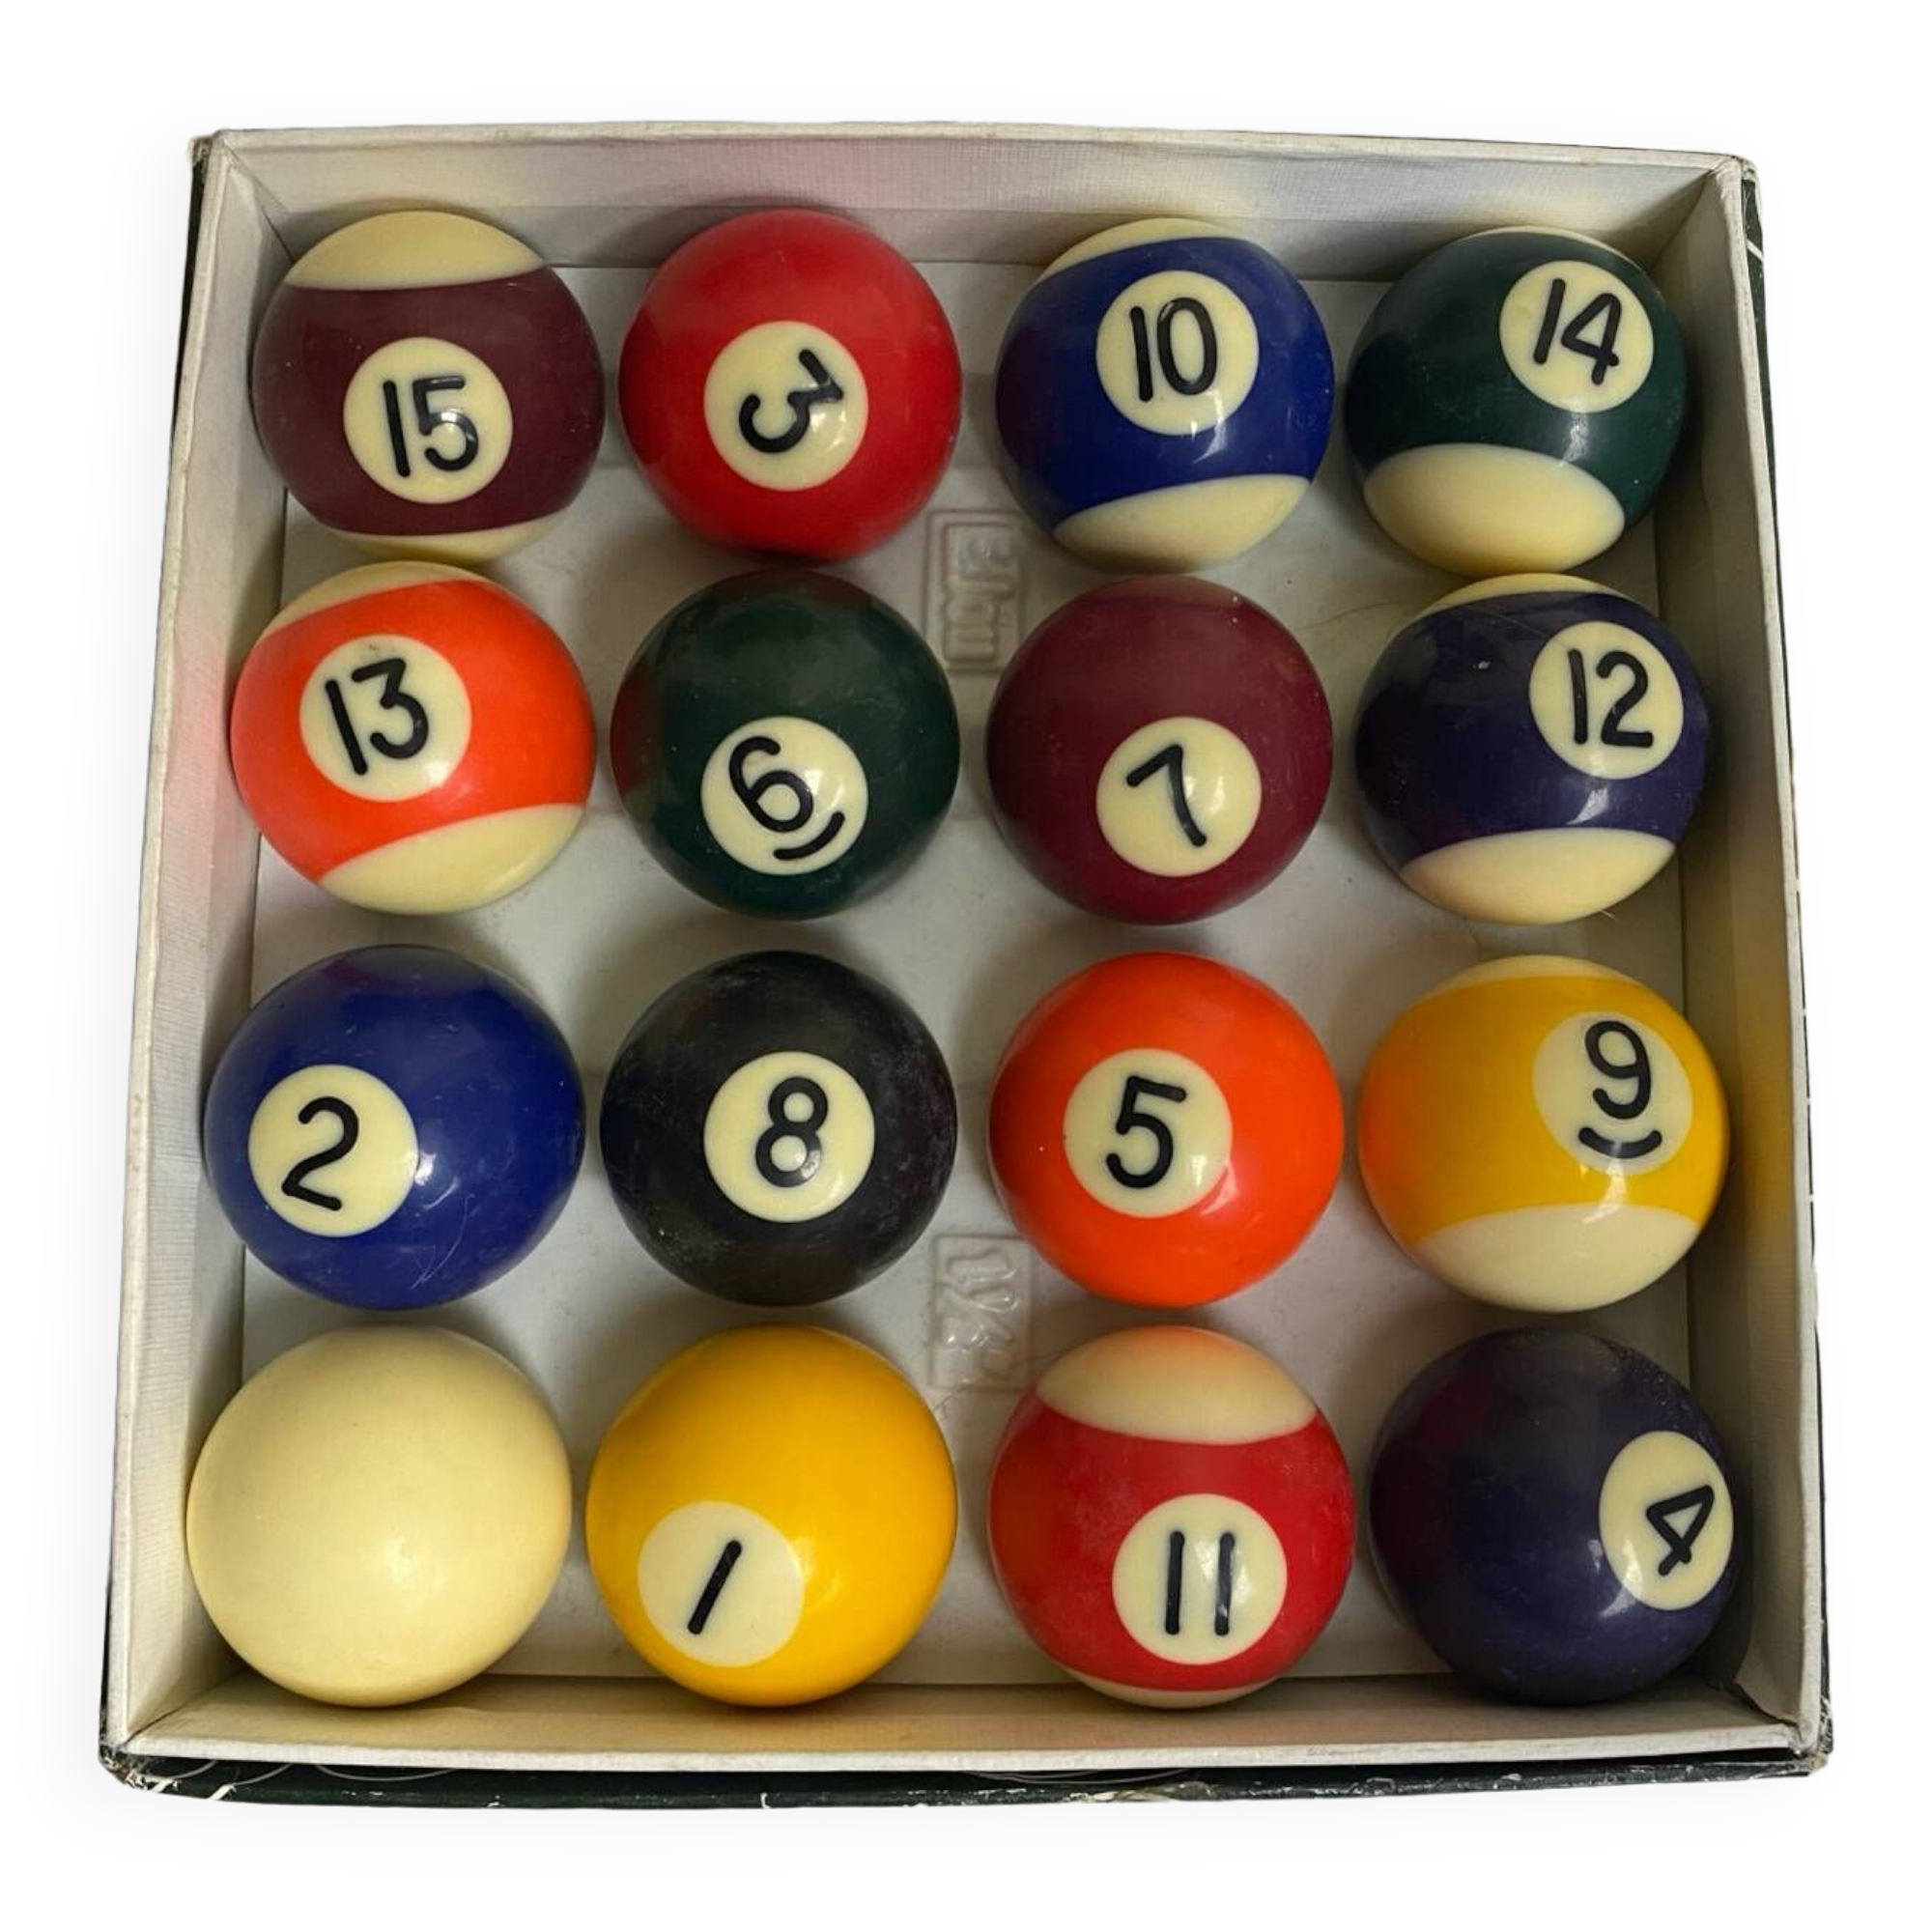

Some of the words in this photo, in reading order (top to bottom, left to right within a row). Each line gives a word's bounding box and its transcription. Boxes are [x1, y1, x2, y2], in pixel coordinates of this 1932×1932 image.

[1128, 297, 1218, 404] 10
[1532, 277, 1623, 386] 14
[382, 375, 480, 478] 15
[737, 348, 845, 456] 3
[324, 657, 430, 777] 13
[1566, 648, 1655, 750] 12
[727, 735, 814, 834] 6
[1124, 743, 1208, 848] 7
[1582, 1020, 1653, 1121] 9
[280, 1095, 359, 1211] 2
[753, 1075, 829, 1188] 8
[1104, 1073, 1188, 1190] 5
[1164, 1530, 1236, 1637] 11
[1644, 1483, 1716, 1577] 4
[686, 1539, 743, 1635] 1
